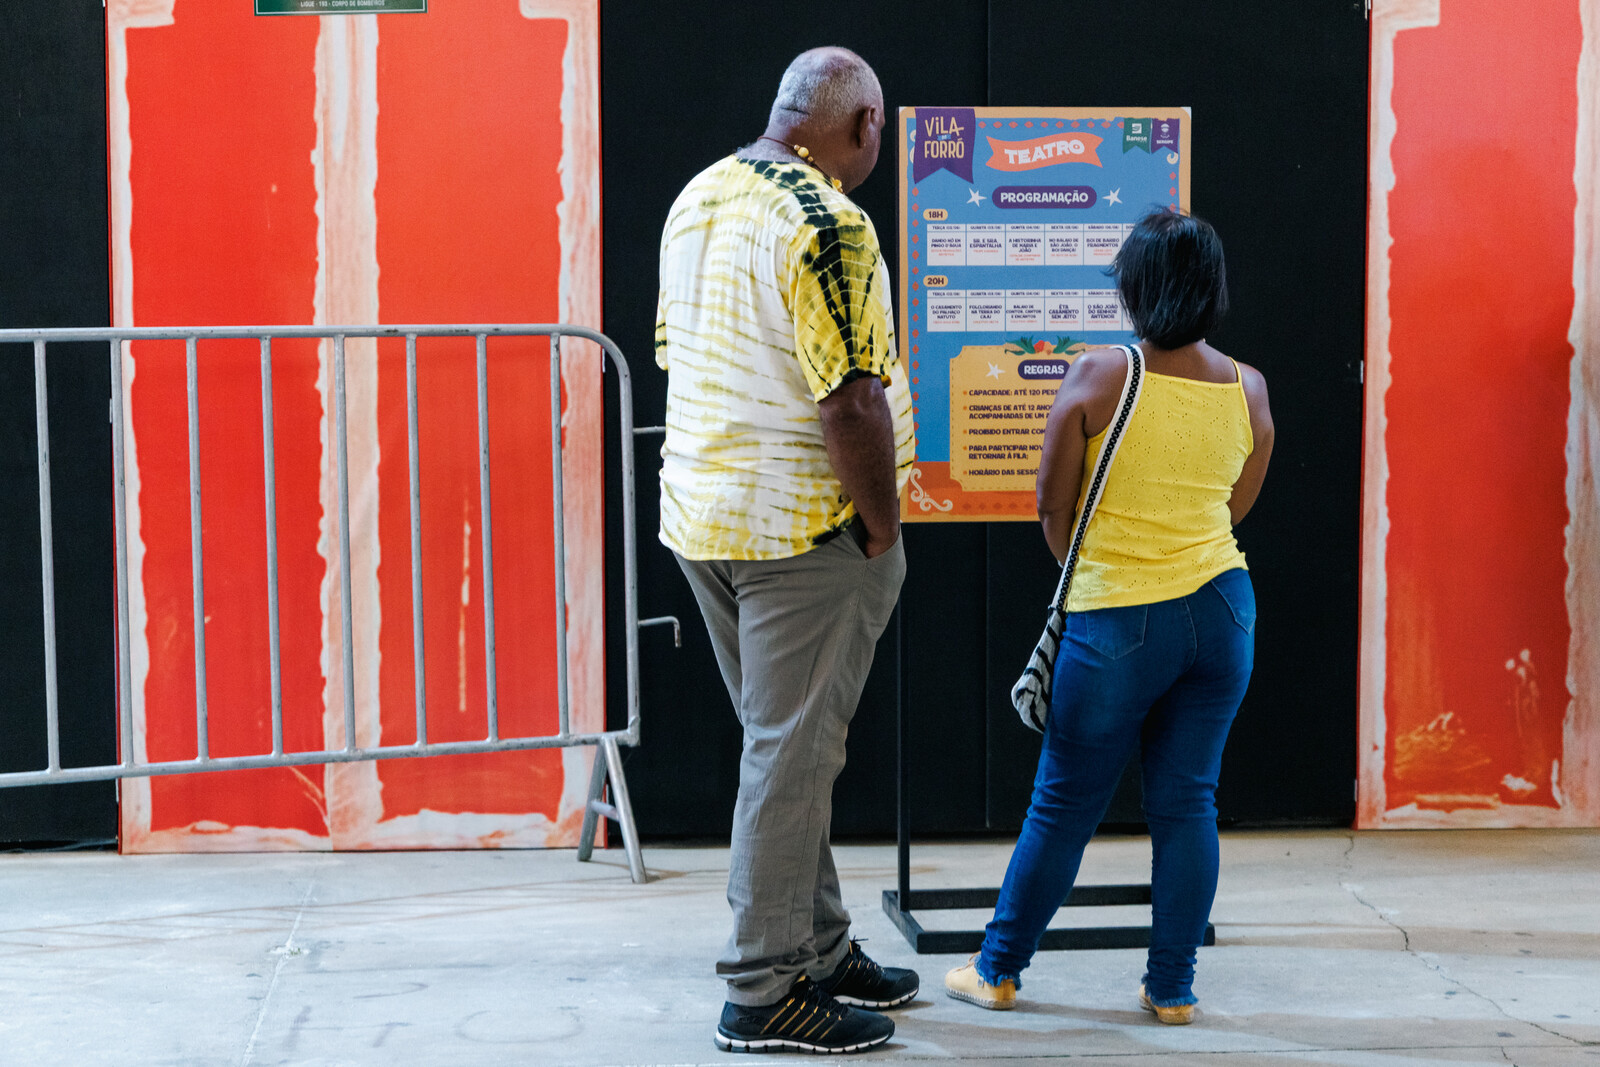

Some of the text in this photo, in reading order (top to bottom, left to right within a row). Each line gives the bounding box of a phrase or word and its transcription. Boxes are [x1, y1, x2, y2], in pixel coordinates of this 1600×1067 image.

[924, 138, 965, 159] FORRÓ
[1004, 139, 1085, 165] TEATRO
[1000, 189, 1089, 206] PROGRAMAÇÃO
[1024, 365, 1065, 375] REGRAS
